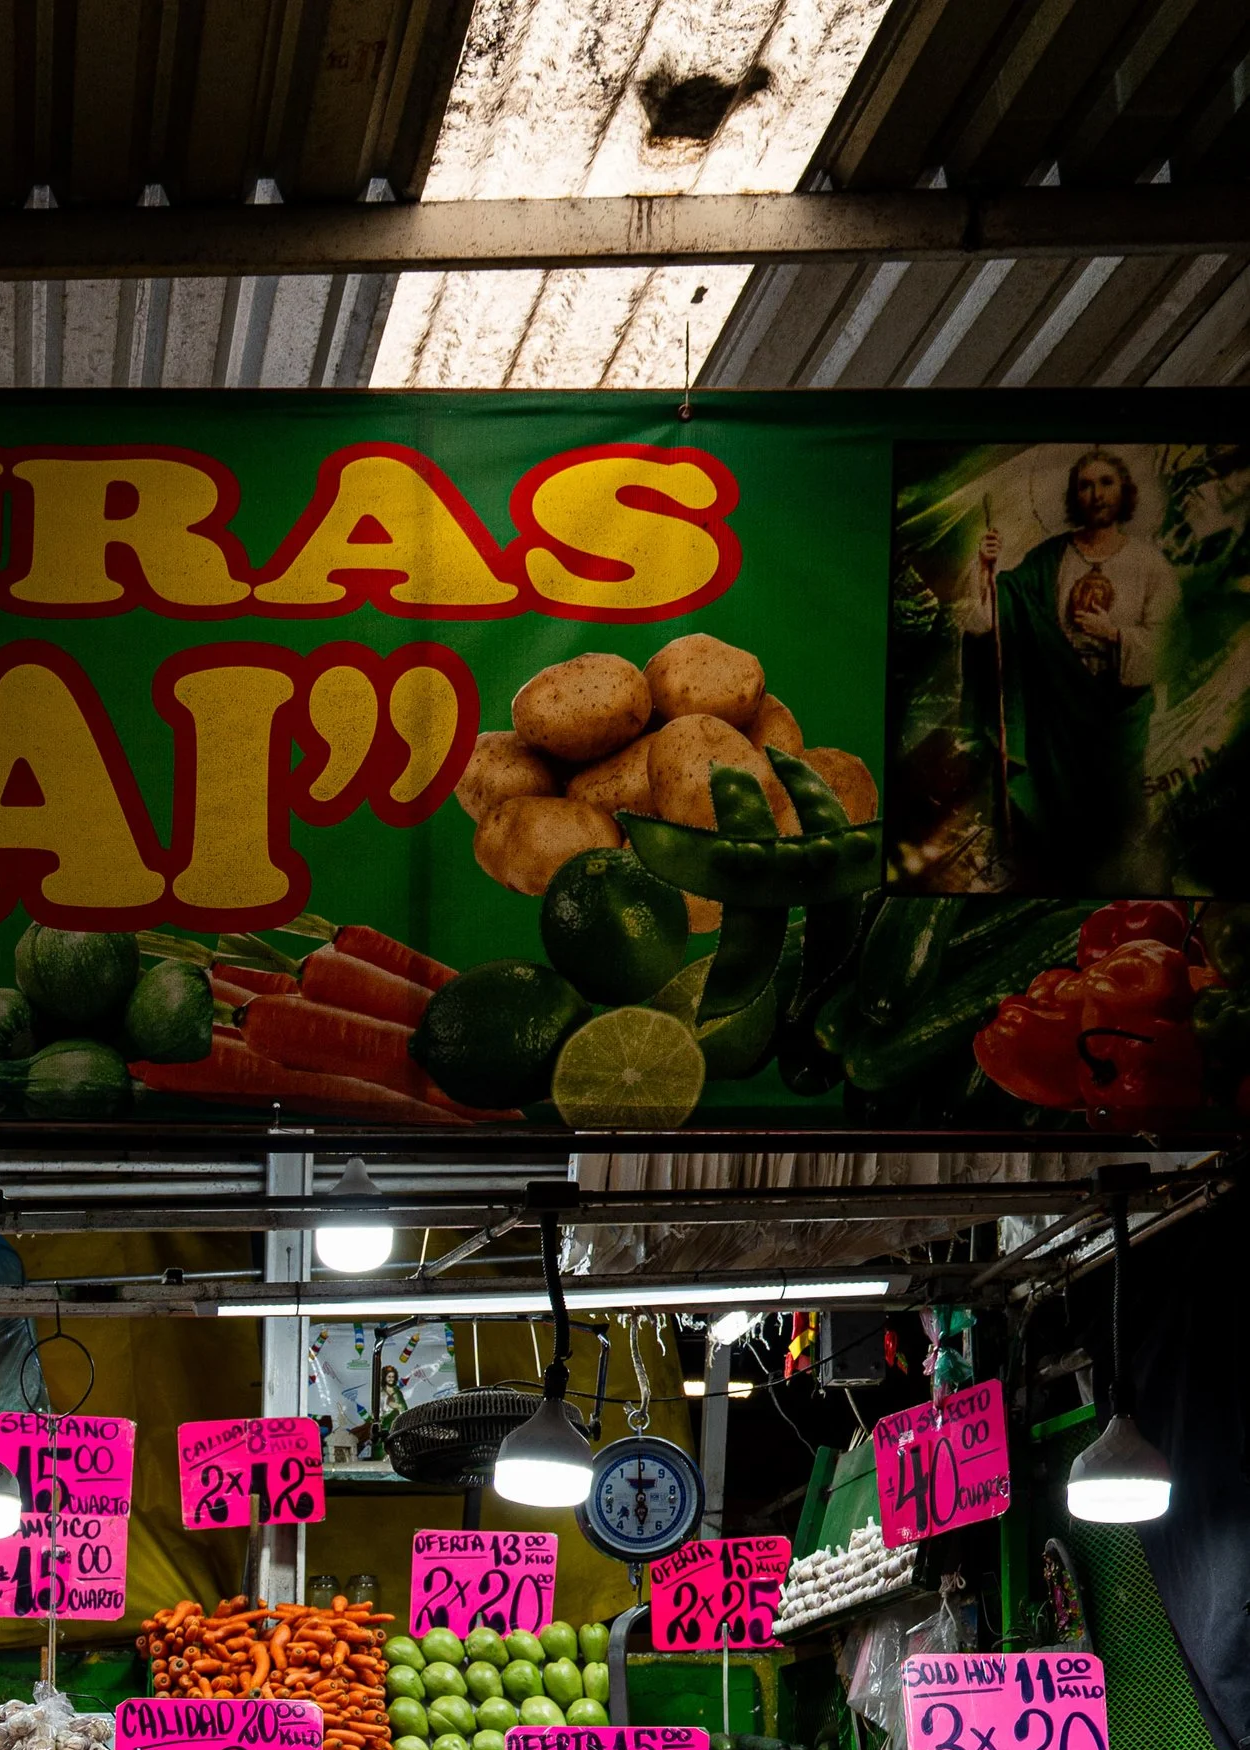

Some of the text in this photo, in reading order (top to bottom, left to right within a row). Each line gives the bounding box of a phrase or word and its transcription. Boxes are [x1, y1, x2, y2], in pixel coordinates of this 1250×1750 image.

[0, 1414, 119, 1440] SERRANO
[74, 1445, 114, 1474] 00
[619, 1468, 624, 1479] 1
[658, 1469, 665, 1479] 9
[605, 1484, 613, 1494] 2
[669, 1485, 676, 1495] 8
[67, 1495, 129, 1515] CUARTO
[605, 1504, 613, 1514] 3
[669, 1506, 676, 1516] 7
[616, 1521, 624, 1530] 4
[637, 1526, 644, 1536] 5
[655, 1521, 662, 1530] 6
[415, 1534, 547, 1567] OFERTA 13 00
[78, 1543, 112, 1574] 00
[524, 1553, 554, 1565] KILO
[651, 1540, 778, 1584] OFERTA 15 00
[755, 1561, 787, 1574] KILO
[68, 1588, 124, 1610] CUARTO
[902, 1657, 1091, 1704] SOLO HOY 11 00
[1057, 1684, 1104, 1699] KILO
[122, 1699, 306, 1744] CALIDAD 20 00
[278, 1729, 323, 1748] KILO
[661, 1727, 693, 1742] 00
